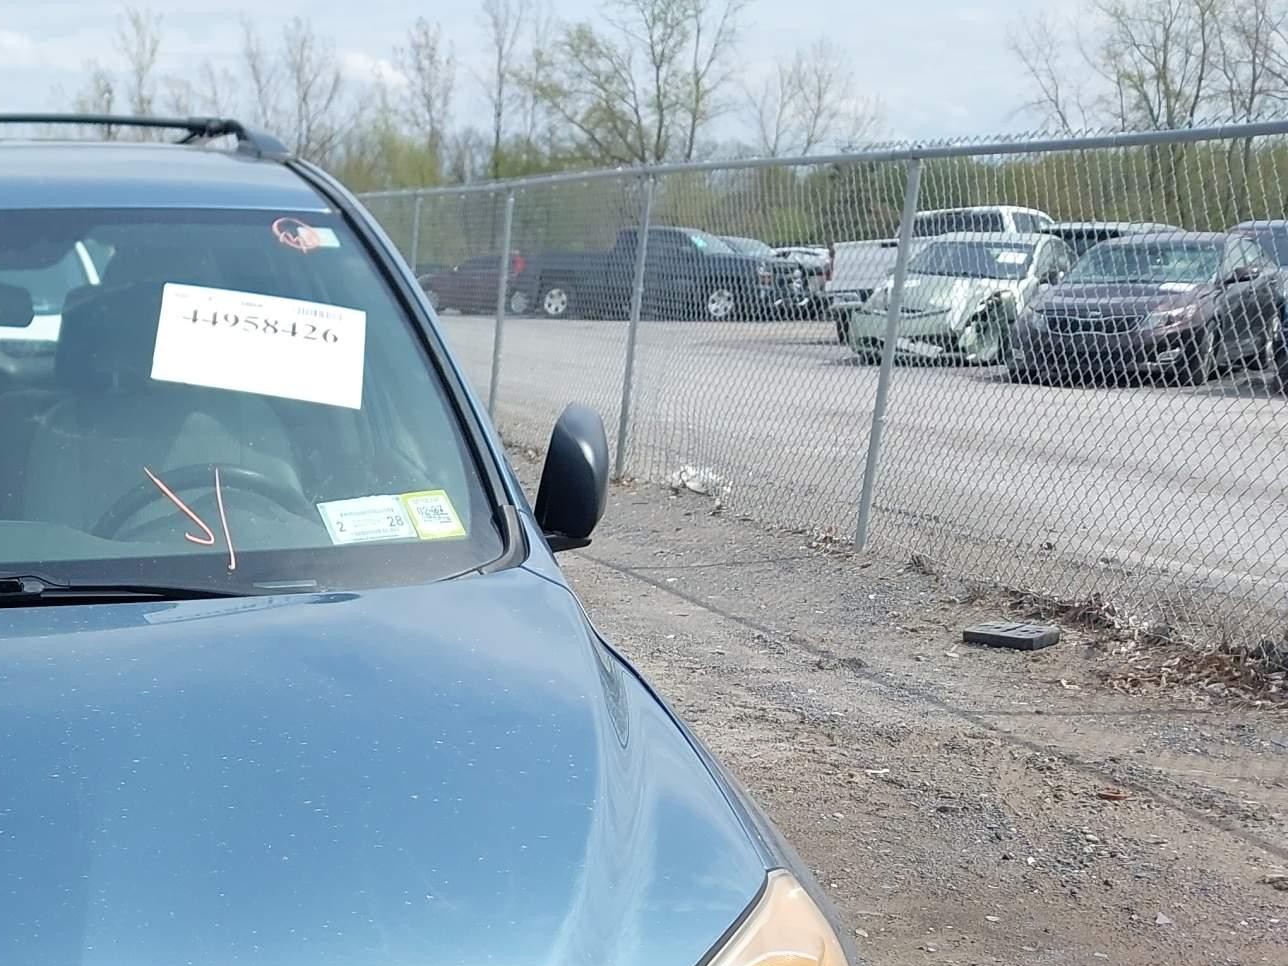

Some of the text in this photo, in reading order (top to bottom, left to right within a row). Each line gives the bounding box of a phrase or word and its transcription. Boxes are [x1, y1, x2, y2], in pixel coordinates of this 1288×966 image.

[183, 308, 339, 343] 44958426
[336, 521, 347, 533] 2
[386, 515, 405, 528] 28
